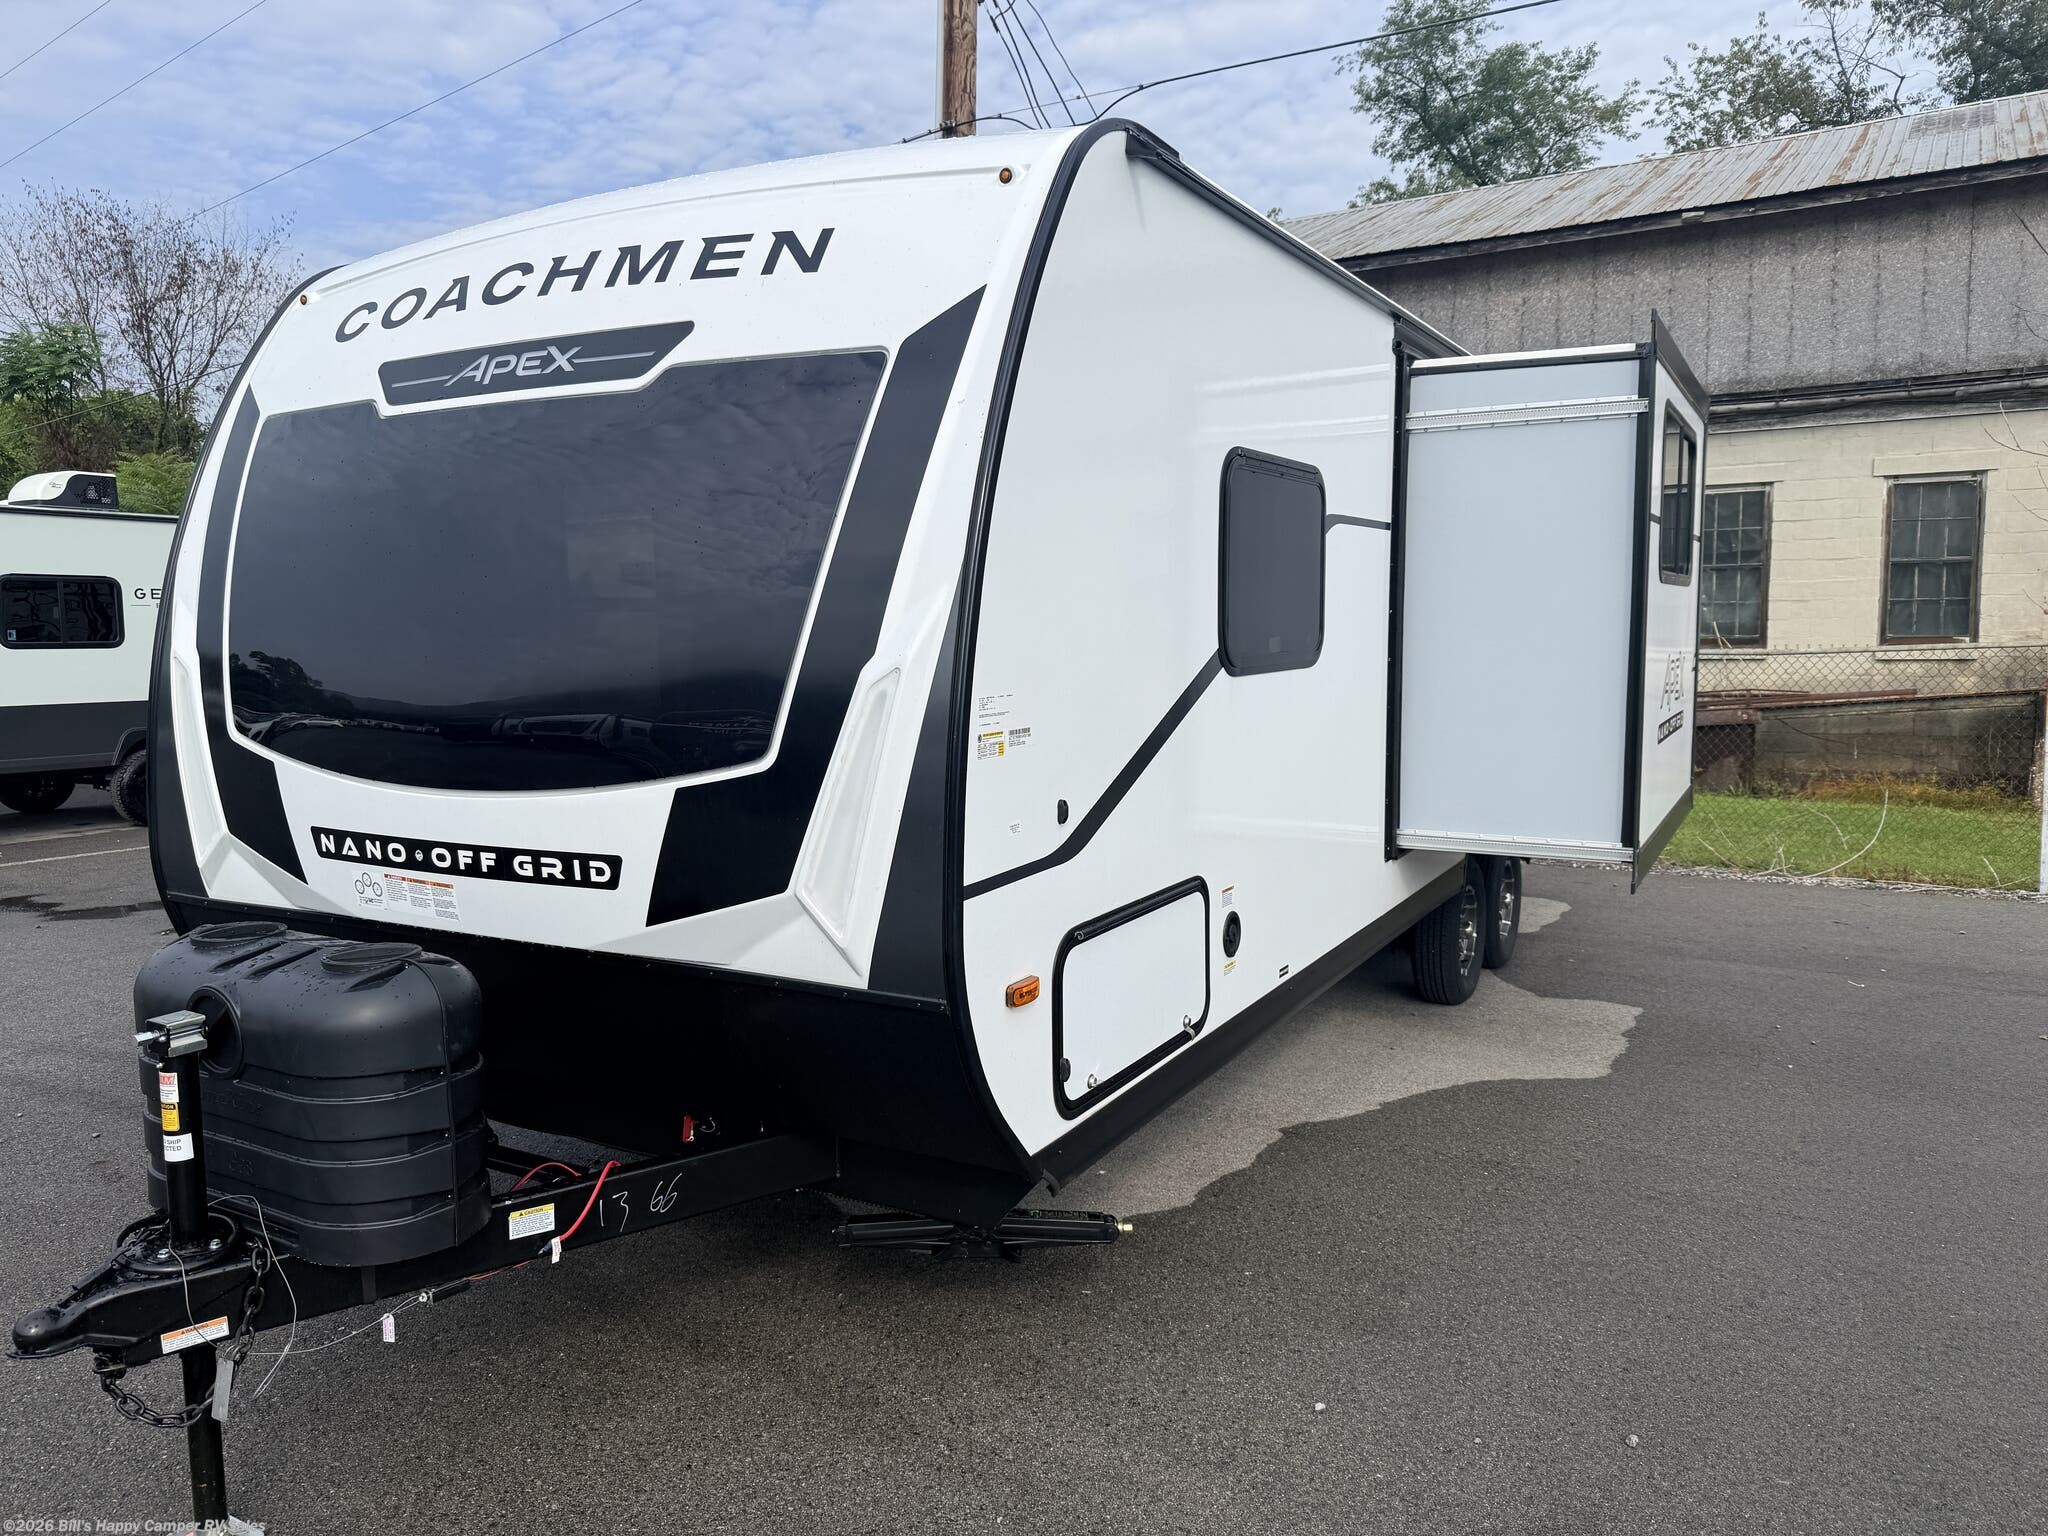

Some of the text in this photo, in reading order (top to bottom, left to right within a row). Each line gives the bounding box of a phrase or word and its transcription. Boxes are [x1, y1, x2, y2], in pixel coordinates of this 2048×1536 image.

[335, 228, 835, 343] COACHMEN
[444, 345, 583, 387] APEX
[320, 833, 612, 883] NANO OFF GRID
